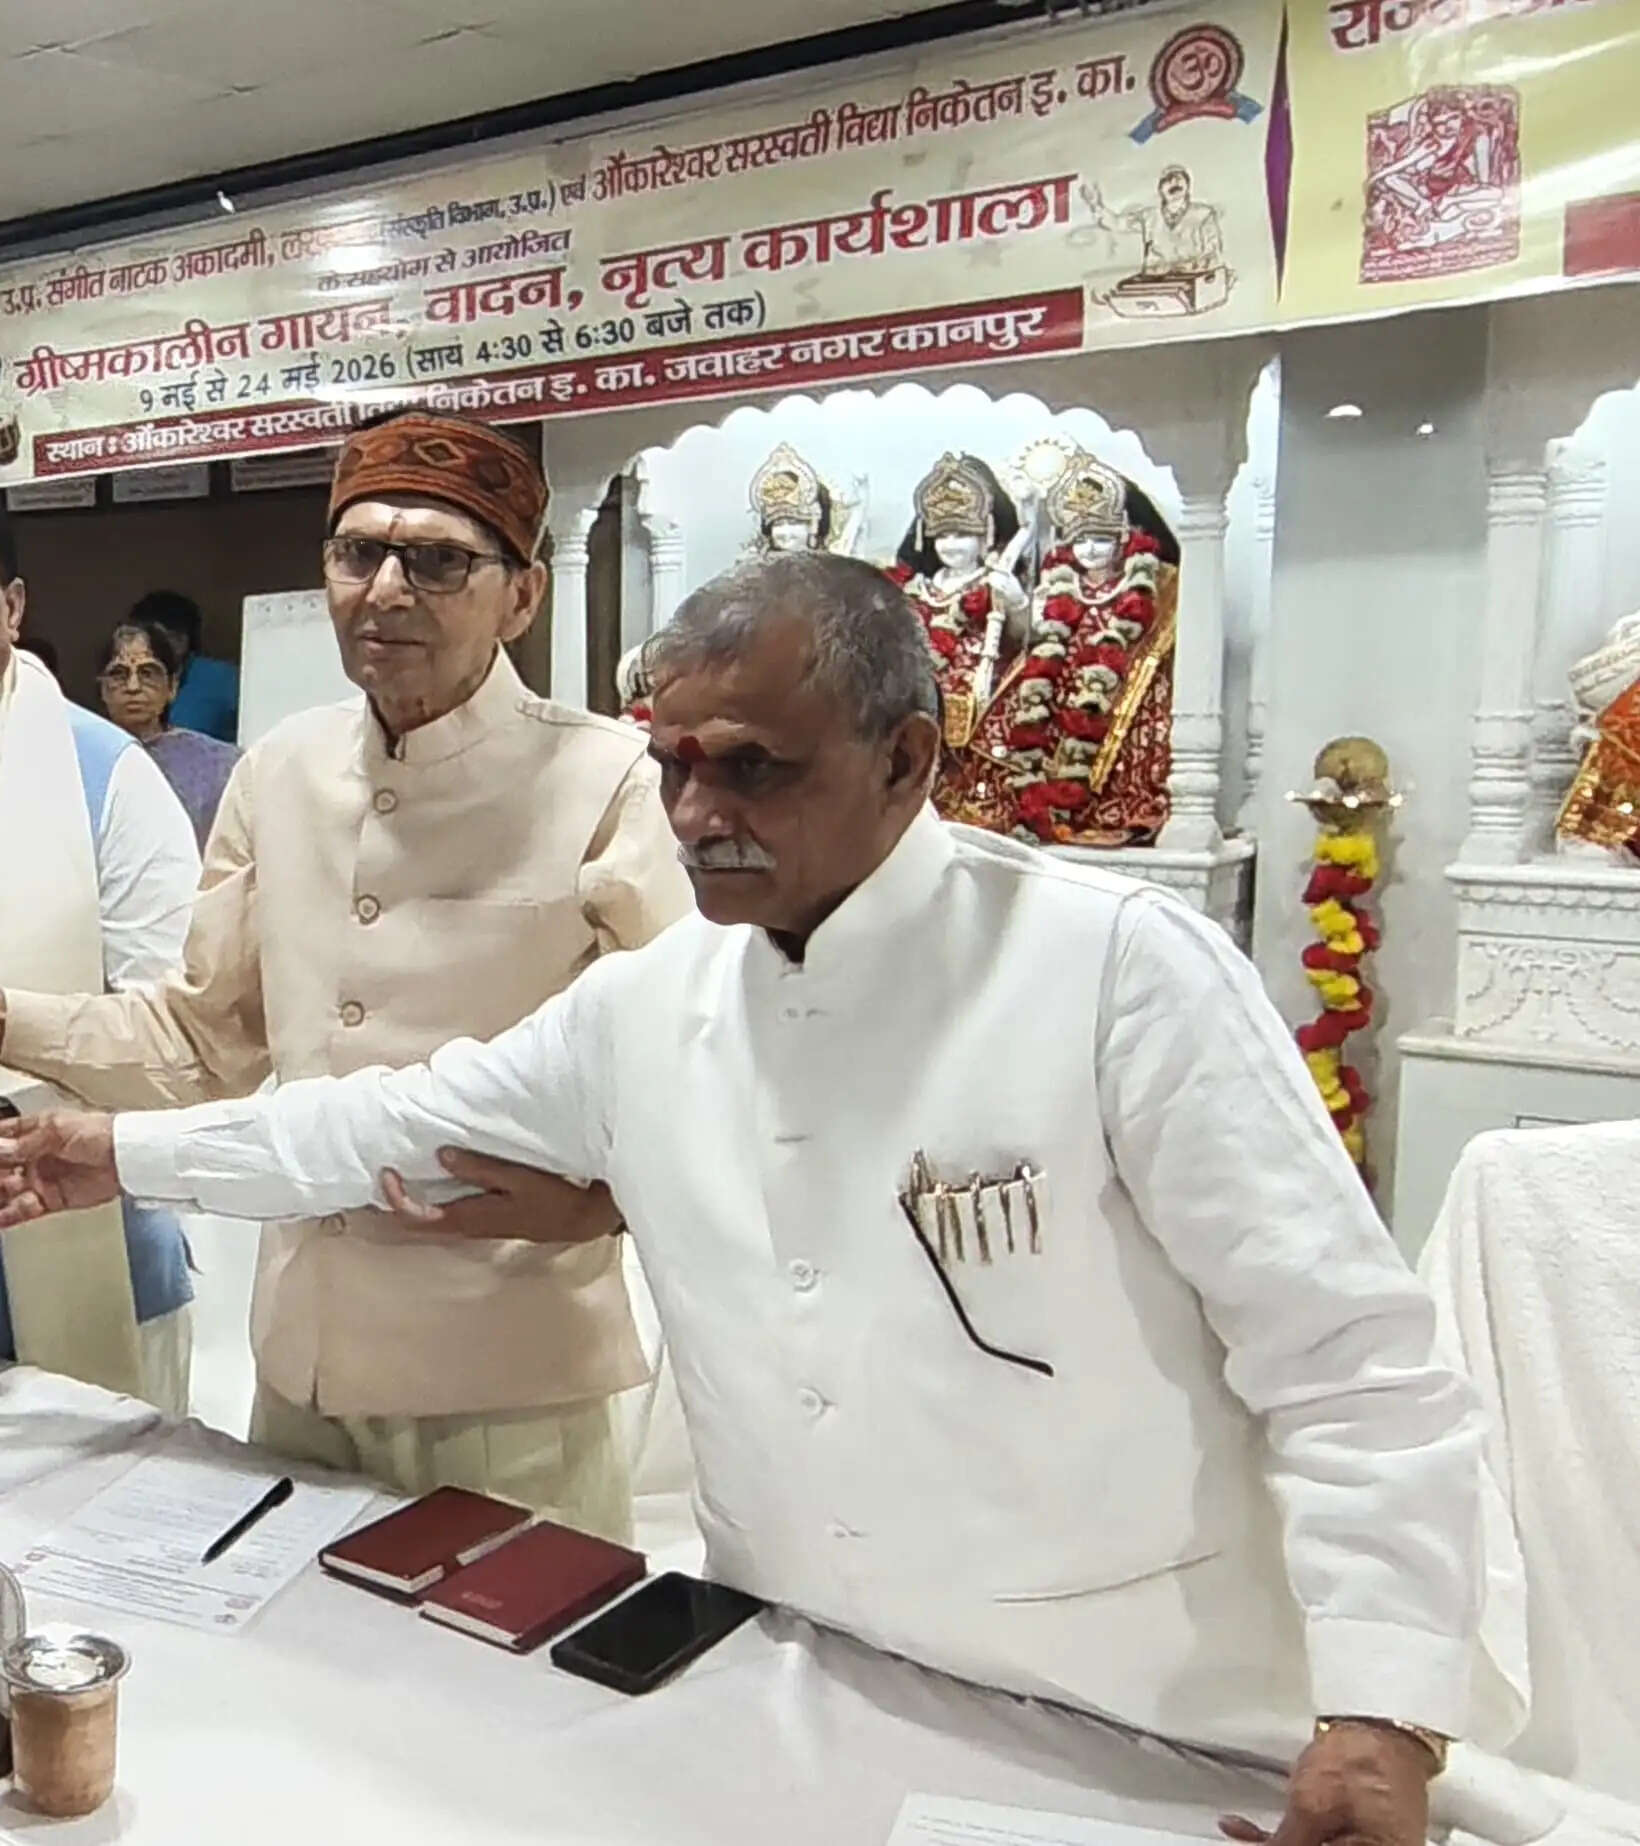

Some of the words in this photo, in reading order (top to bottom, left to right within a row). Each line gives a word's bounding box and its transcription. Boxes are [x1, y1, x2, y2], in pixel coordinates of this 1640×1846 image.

[1, 286, 43, 317] उ.प्र.
[46, 267, 106, 306] संगीत
[109, 257, 169, 292] नाटक
[173, 227, 276, 283] अकादमी,
[724, 108, 833, 174] सरस्वती
[835, 102, 902, 153] विद्या
[903, 79, 1026, 137] निकेतन
[1029, 69, 1068, 118] इ.
[1076, 54, 1136, 99] का.
[434, 247, 457, 273] से
[462, 227, 572, 270] आयोजित
[13, 318, 252, 398] ग्रीष्मकालीन
[423, 266, 584, 324] वादन,
[599, 236, 731, 309] नृत्य
[741, 172, 1080, 271] कार्यशाला
[139, 389, 154, 413] 9
[160, 373, 199, 412] मई
[205, 367, 229, 401] से
[237, 374, 271, 399] 24
[280, 351, 320, 392] मई
[332, 353, 396, 384] 2026
[476, 334, 532, 362] 4:30
[539, 319, 564, 355] से
[575, 320, 635, 349] 6:30
[645, 298, 693, 336] बजे
[703, 289, 767, 332] तक)
[250, 398, 351, 435] सरस्वती
[427, 377, 544, 412] निकेतन
[549, 373, 587, 400] इ.
[594, 360, 656, 391] का.
[663, 344, 785, 382] जवाहर
[787, 329, 886, 365] नगर
[890, 306, 1048, 351] कानपुर
